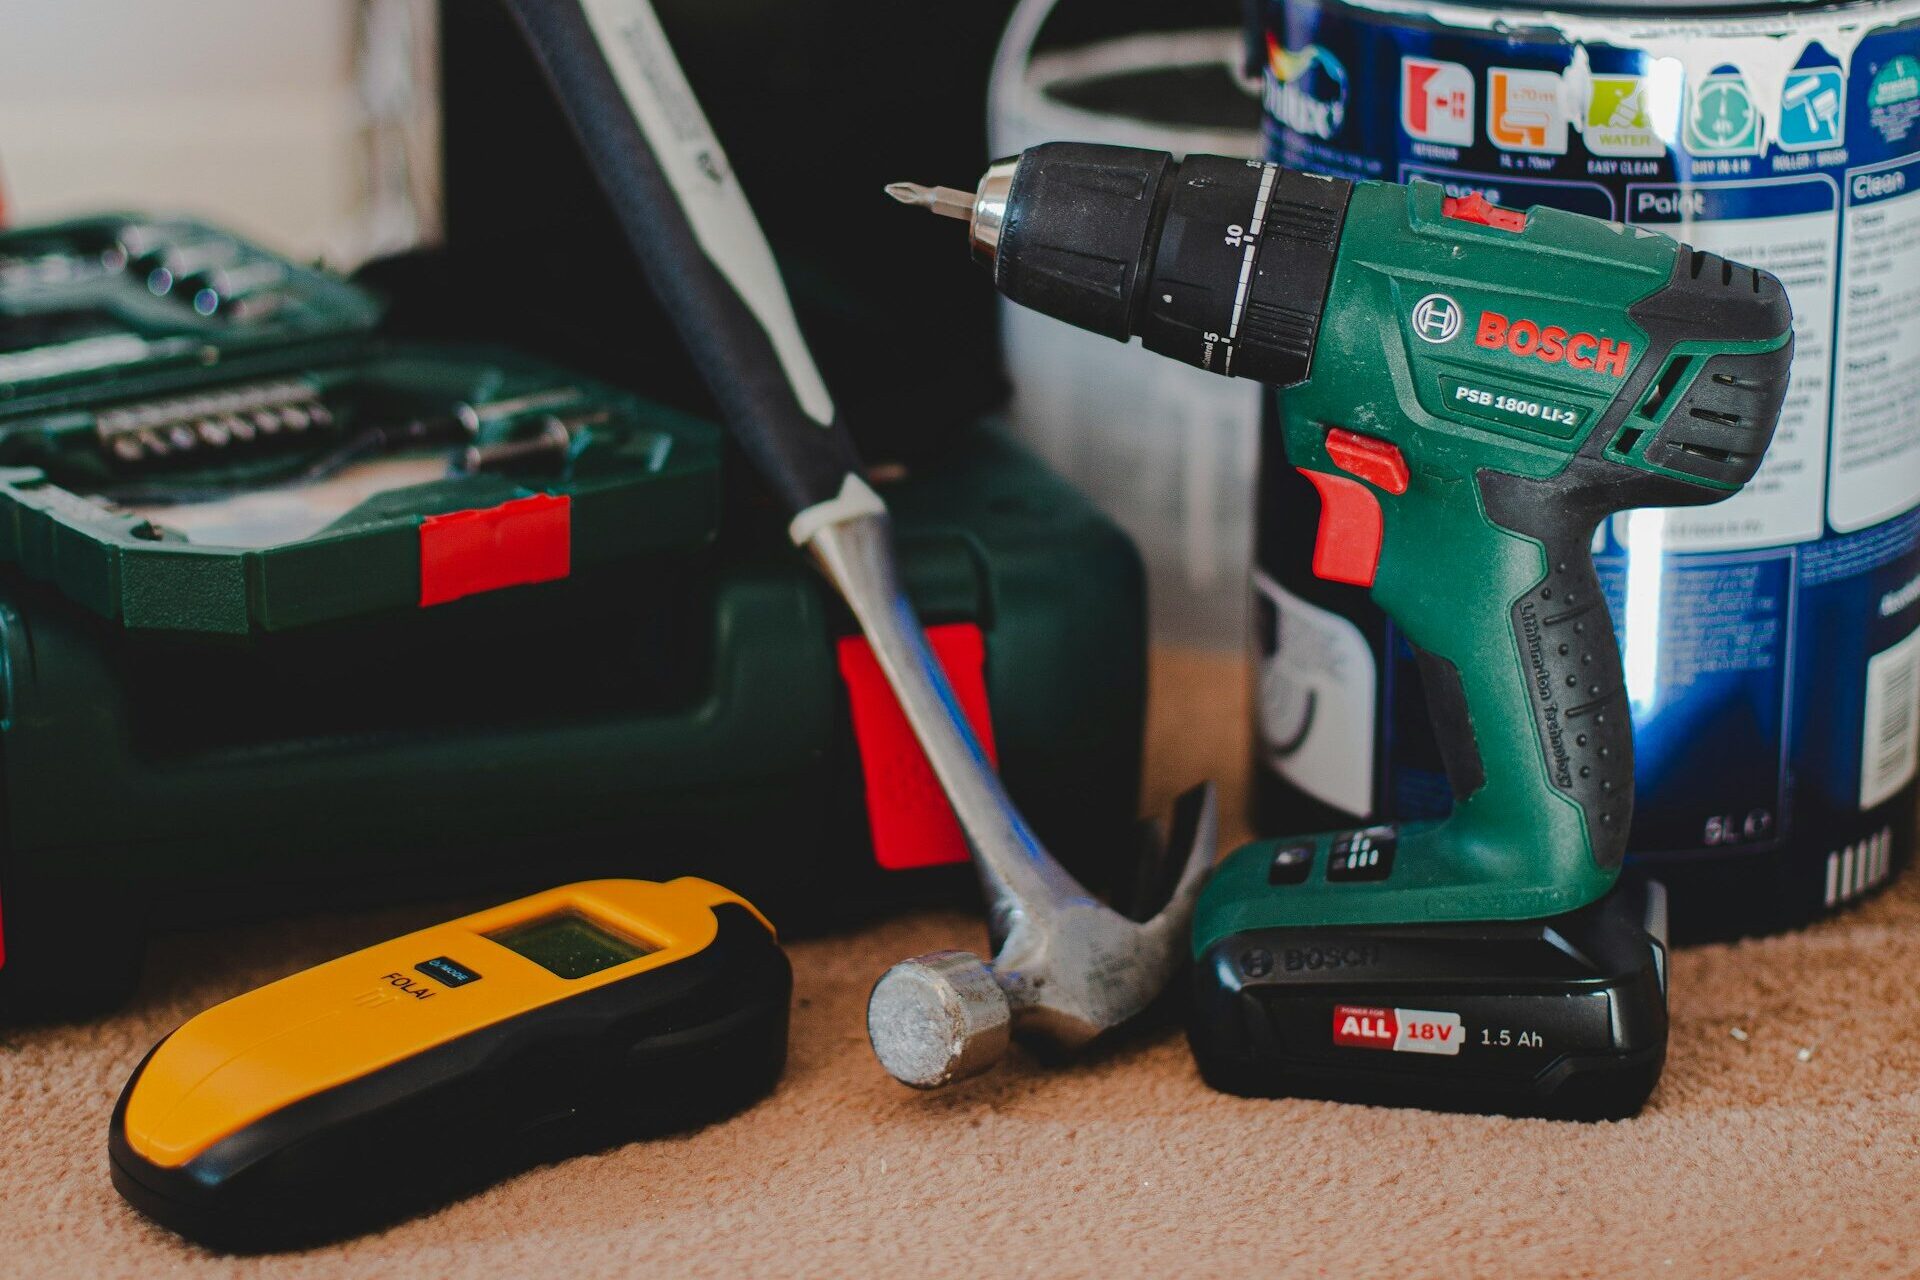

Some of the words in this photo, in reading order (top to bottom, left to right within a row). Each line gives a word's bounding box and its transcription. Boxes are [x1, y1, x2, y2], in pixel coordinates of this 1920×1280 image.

[1600, 133, 1650, 147] WATER
[1587, 159, 1617, 174] EASY
[1620, 160, 1659, 175] CLEAN
[1853, 170, 1906, 199] Clean
[1637, 192, 1705, 215] Paint
[1225, 224, 1244, 248] 10
[1204, 331, 1219, 342] 5
[1475, 310, 1631, 378] BOSCH
[1455, 386, 1494, 406] PSB
[1495, 396, 1541, 418] 1800
[1544, 701, 1573, 789] Technology
[1285, 946, 1379, 971] BOSCH
[380, 972, 437, 1000] FOLAI
[1368, 1008, 1385, 1017] FOR
[1340, 1016, 1391, 1038] ALL
[1407, 1022, 1452, 1041] 18V
[1481, 1028, 1511, 1046] 1.5
[1517, 1031, 1543, 1048] Ah
